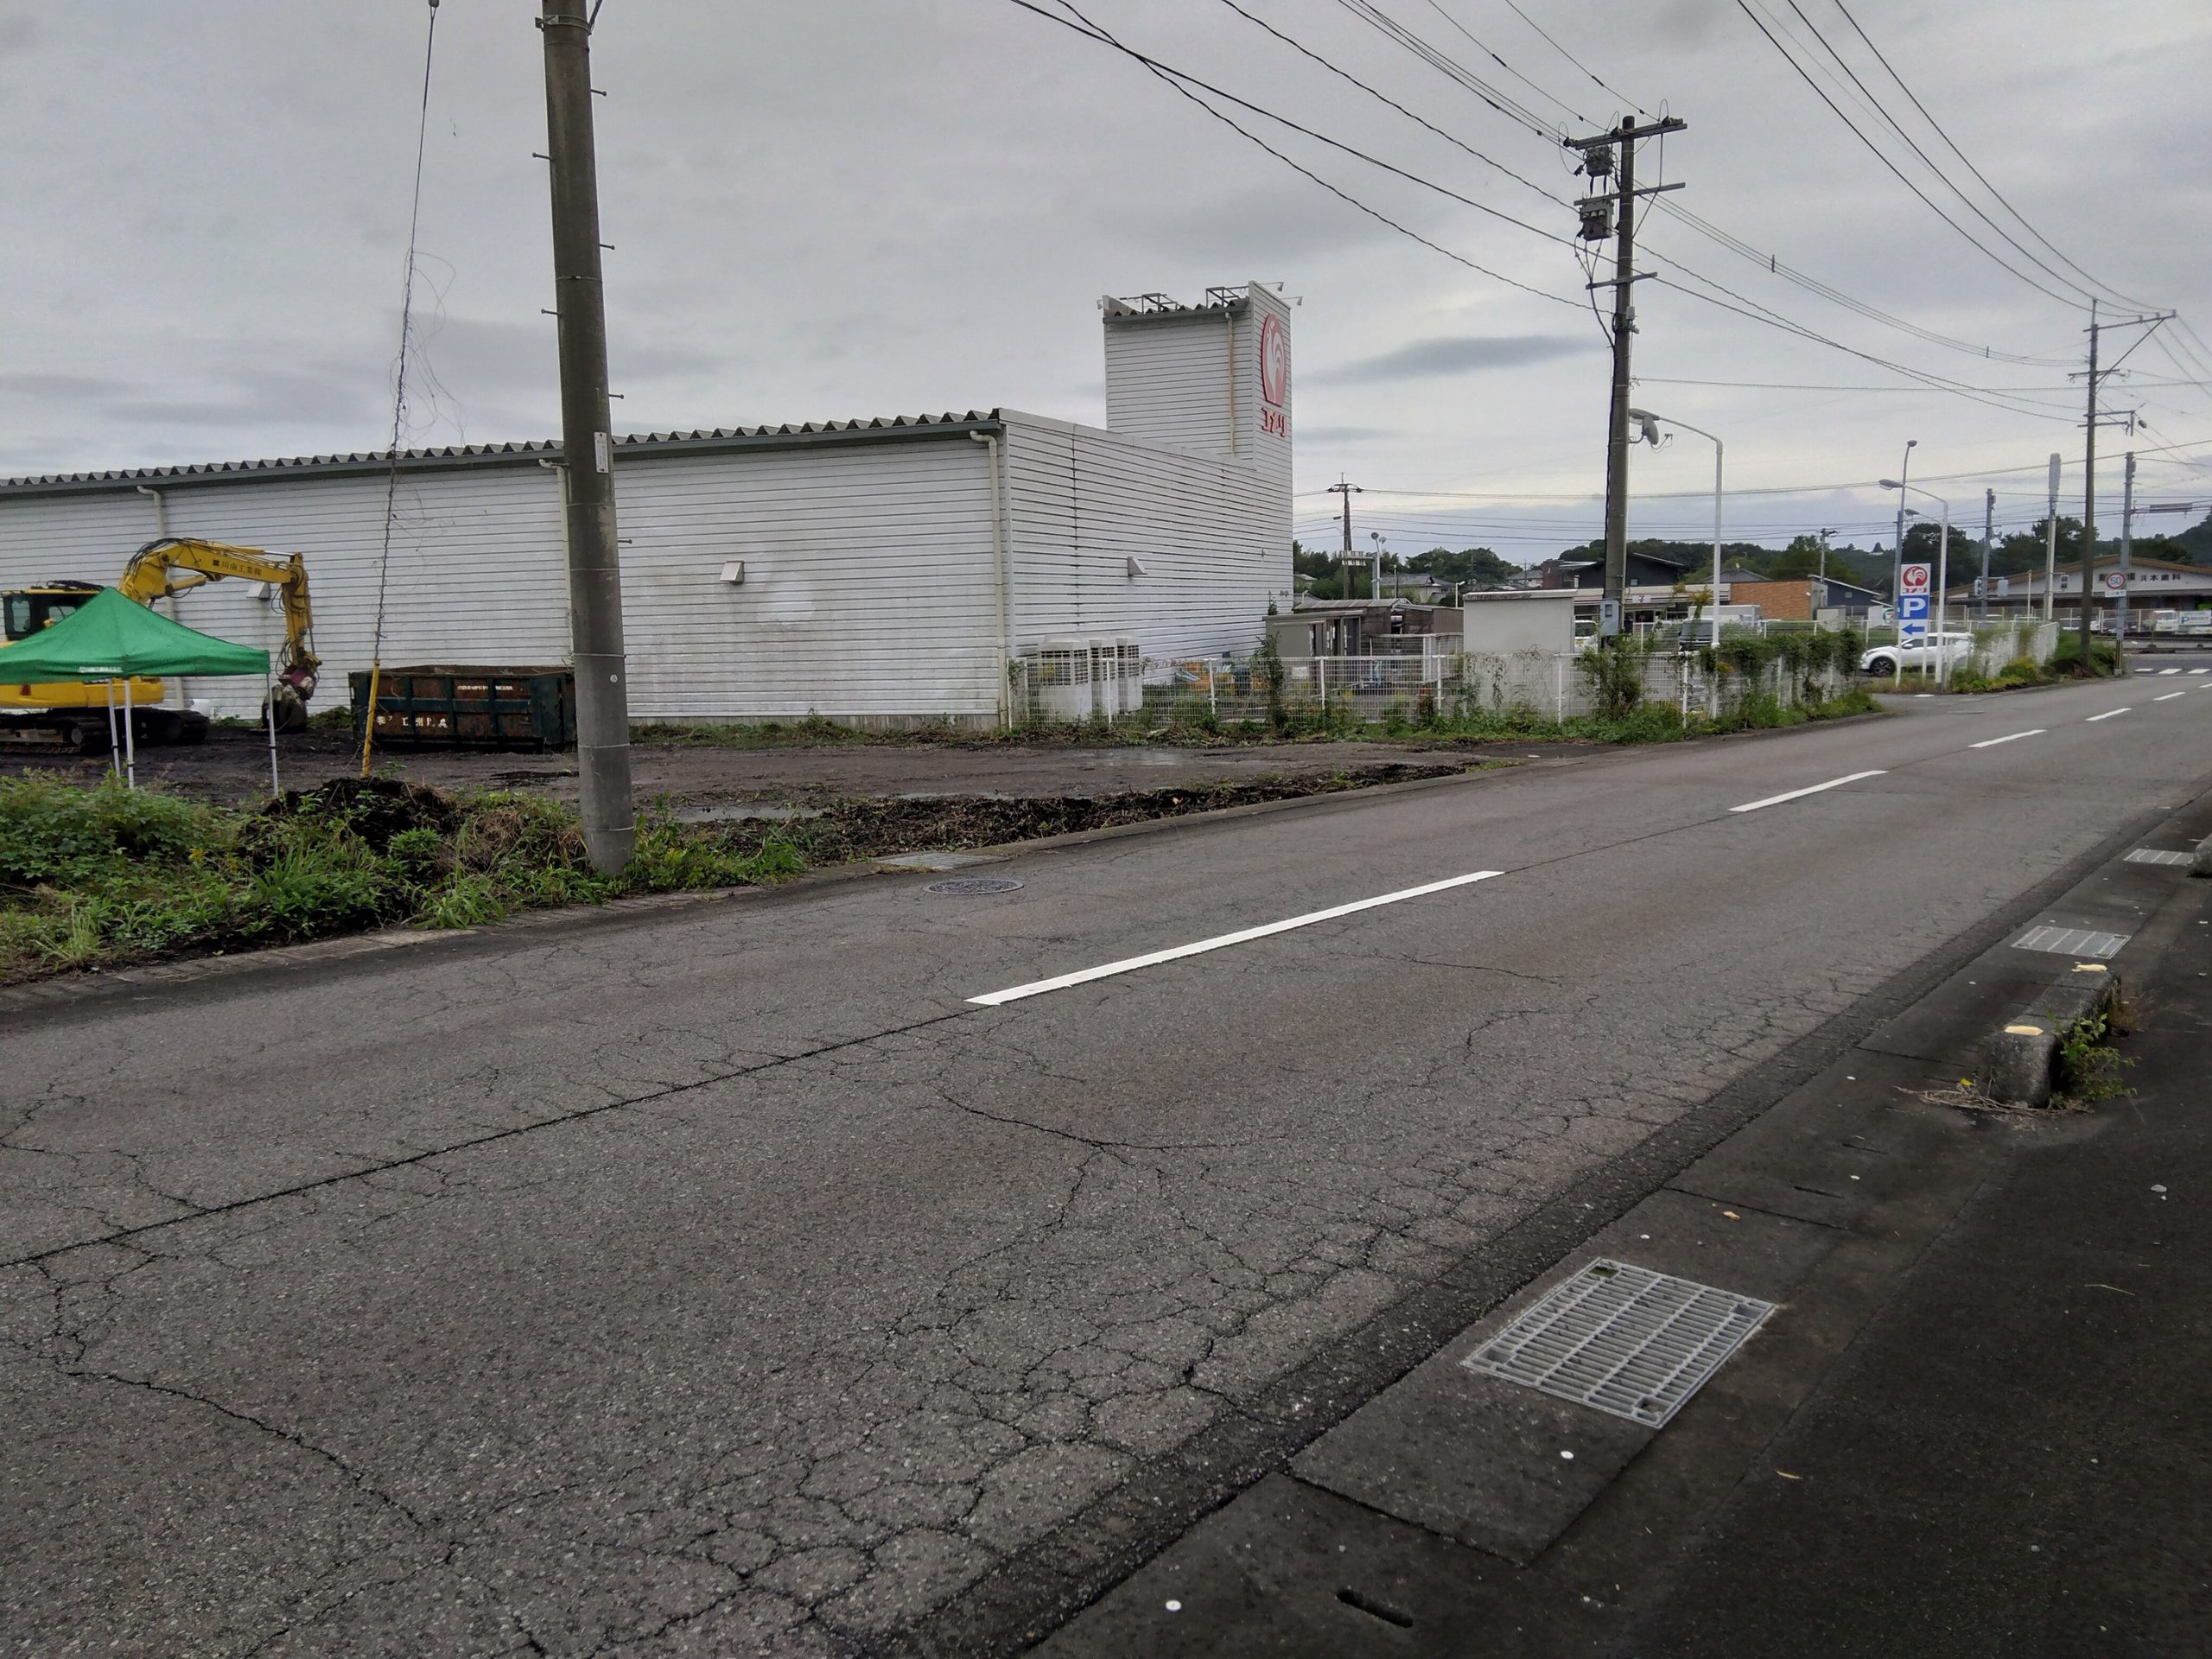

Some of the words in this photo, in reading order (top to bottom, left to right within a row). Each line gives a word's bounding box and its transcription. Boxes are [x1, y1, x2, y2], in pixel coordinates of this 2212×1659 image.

[1262, 407, 1287, 437] コメリ
[2110, 576, 2121, 585] 50
[1904, 598, 1926, 617] P
